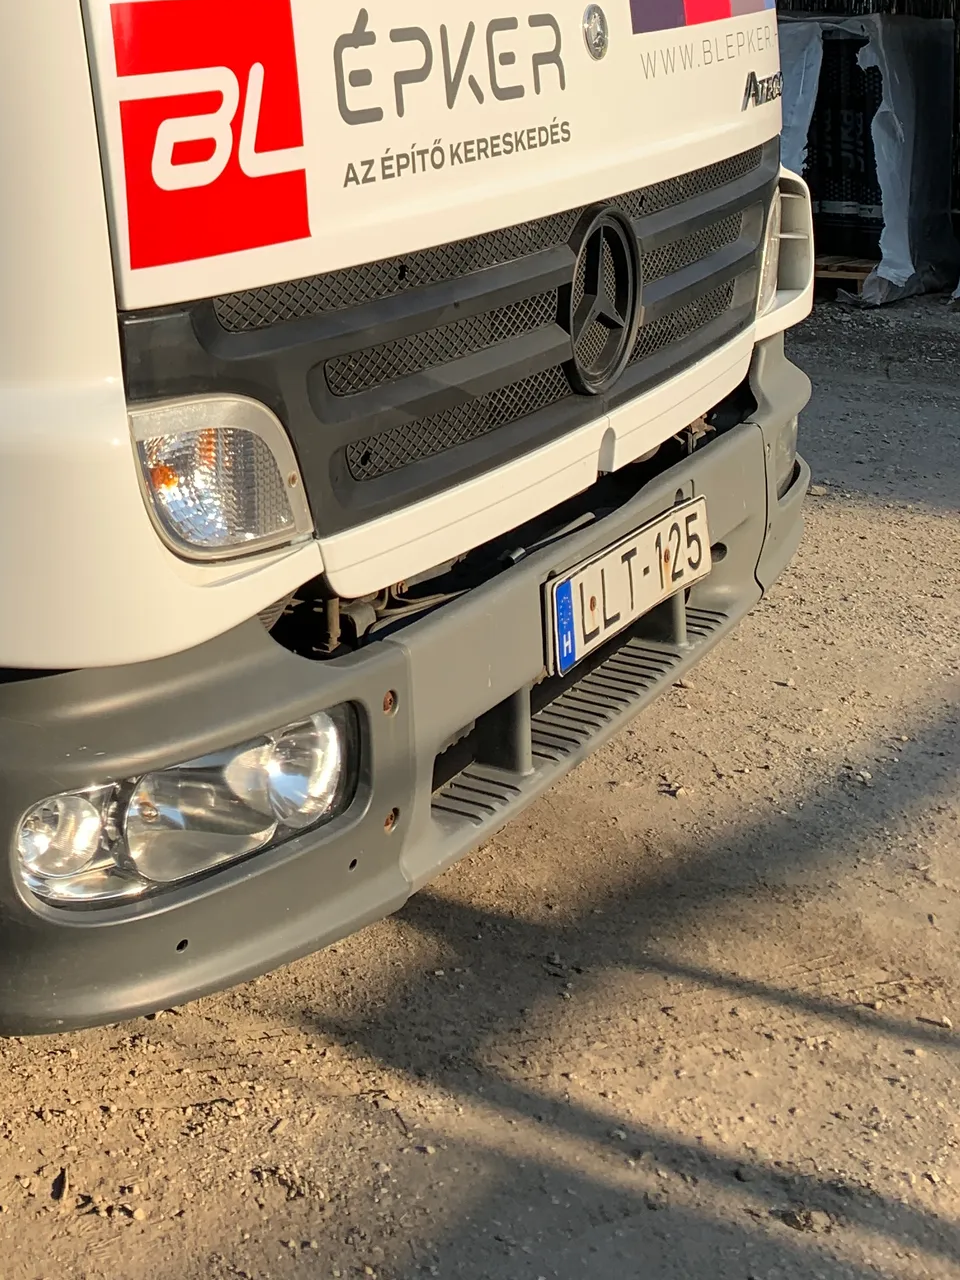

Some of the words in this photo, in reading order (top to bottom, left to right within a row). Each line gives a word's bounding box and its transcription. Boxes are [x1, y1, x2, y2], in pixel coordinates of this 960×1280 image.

[332, 7, 566, 126] ÉPKER
[640, 25, 778, 80] WWW.BLEPKER.
[117, 61, 306, 192] BL
[343, 160, 375, 188] AZ
[381, 137, 446, 182] ÉPÍTŐ
[449, 118, 572, 167] KERESKEDÉS
[579, 512, 702, 645] LLT-125
[563, 631, 572, 657] H
